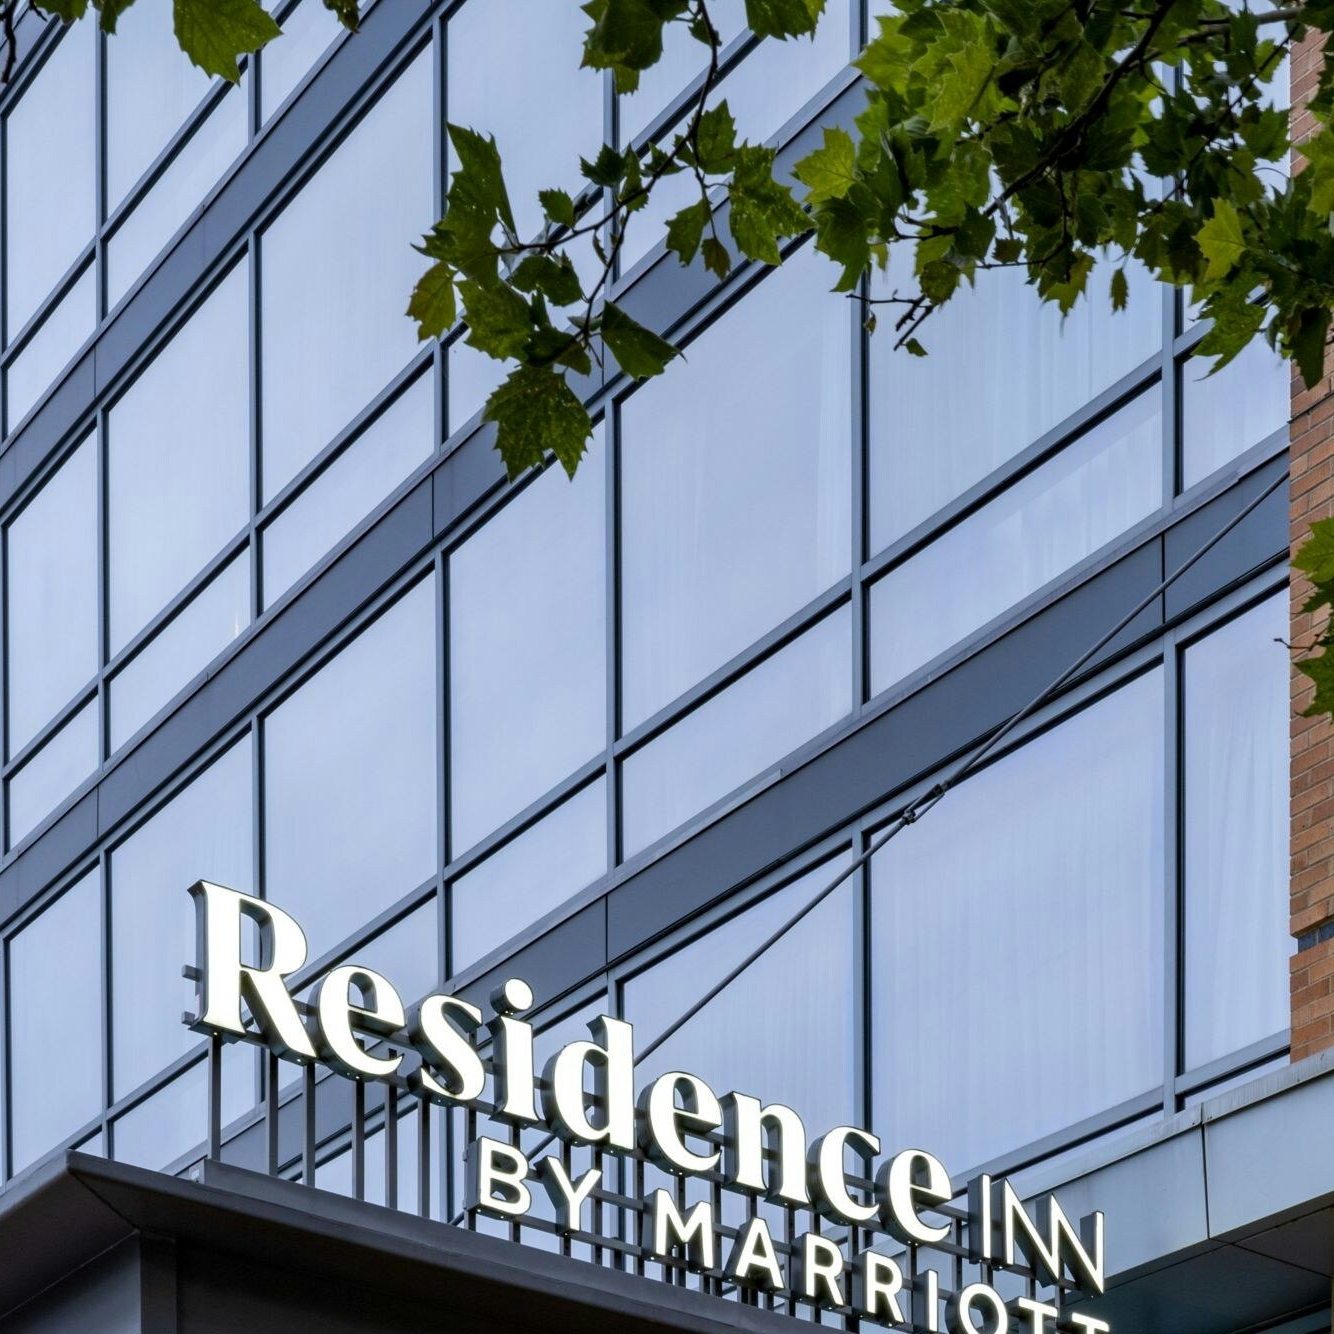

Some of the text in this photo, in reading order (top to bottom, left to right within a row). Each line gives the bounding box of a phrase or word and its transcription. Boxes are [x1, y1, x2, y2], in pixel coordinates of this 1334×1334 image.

[191, 879, 1106, 1295] Residence INN
[474, 1135, 604, 1233] BY
